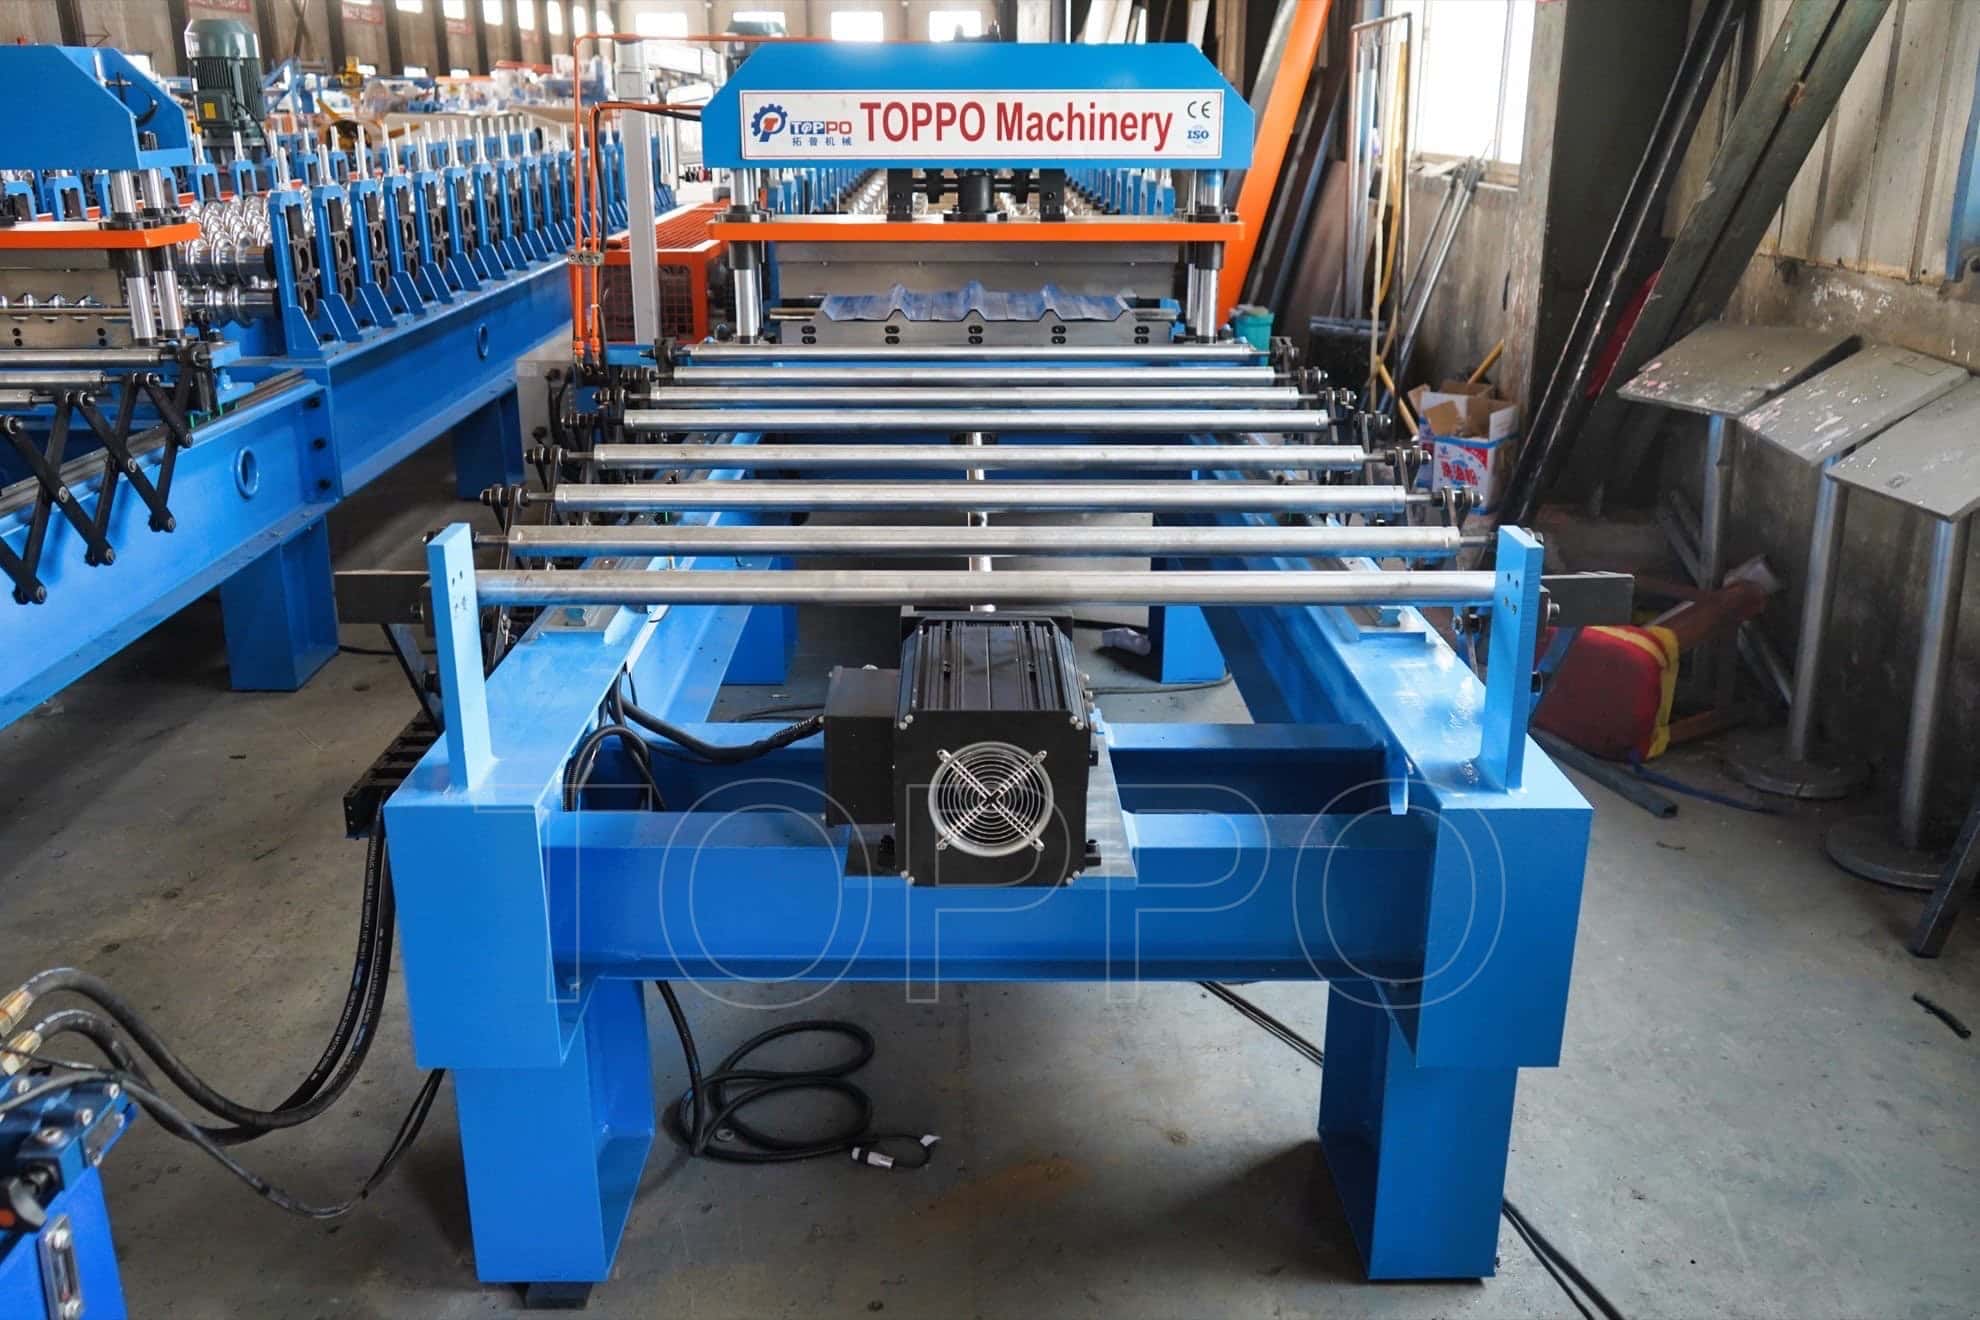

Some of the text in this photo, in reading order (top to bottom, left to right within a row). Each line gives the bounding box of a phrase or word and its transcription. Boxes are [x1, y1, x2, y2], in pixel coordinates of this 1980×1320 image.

[1187, 101, 1211, 119] CE
[790, 121, 852, 134] TOPPO
[860, 101, 1173, 151] TOPPO Machinery
[1187, 130, 1209, 139] ISO
